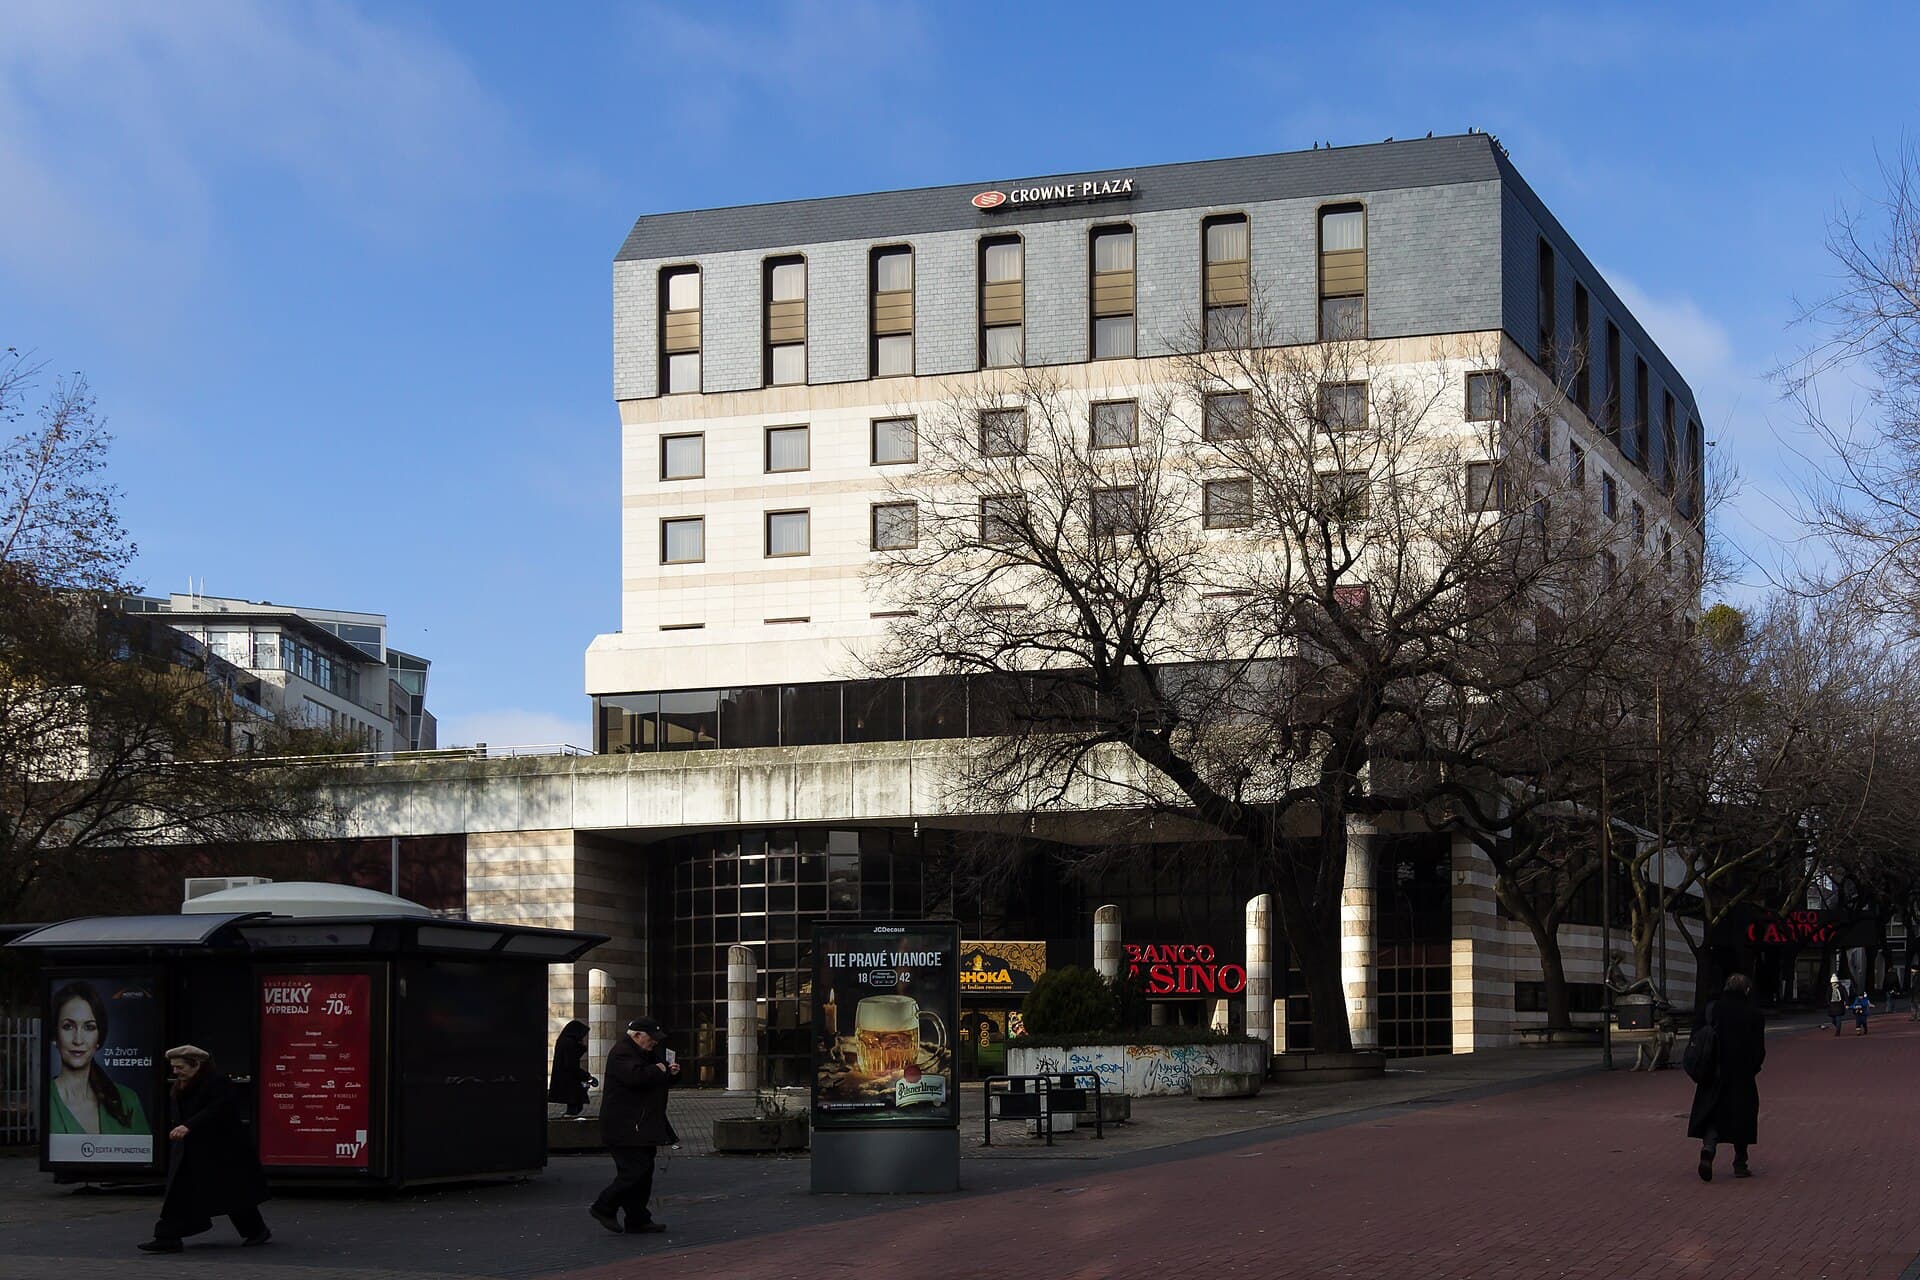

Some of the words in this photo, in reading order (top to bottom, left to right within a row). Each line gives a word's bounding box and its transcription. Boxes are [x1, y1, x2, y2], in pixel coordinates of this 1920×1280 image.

[1010, 183, 1075, 204] CROWNE
[1083, 178, 1132, 196] PLAZA
[827, 953, 846, 968] TIE
[848, 949, 887, 968] PRAVÉ
[890, 952, 942, 967] VIANOCE
[1122, 944, 1215, 963] BANCO
[858, 972, 868, 983] 18
[899, 972, 911, 983] 42
[960, 968, 1012, 983] SHOKA
[1127, 963, 1247, 994] ASINO
[264, 983, 313, 1003] VEĽKÝ
[265, 1003, 309, 1014] VÝPREDAJ
[320, 999, 352, 1015] -70%
[104, 1048, 114, 1056] ZA
[115, 1047, 138, 1056] ŽIVOT
[104, 1058, 110, 1067] V
[112, 1056, 152, 1067] BEZPEČÍ
[898, 1083, 920, 1100] Pilsner
[335, 1143, 360, 1159] my
